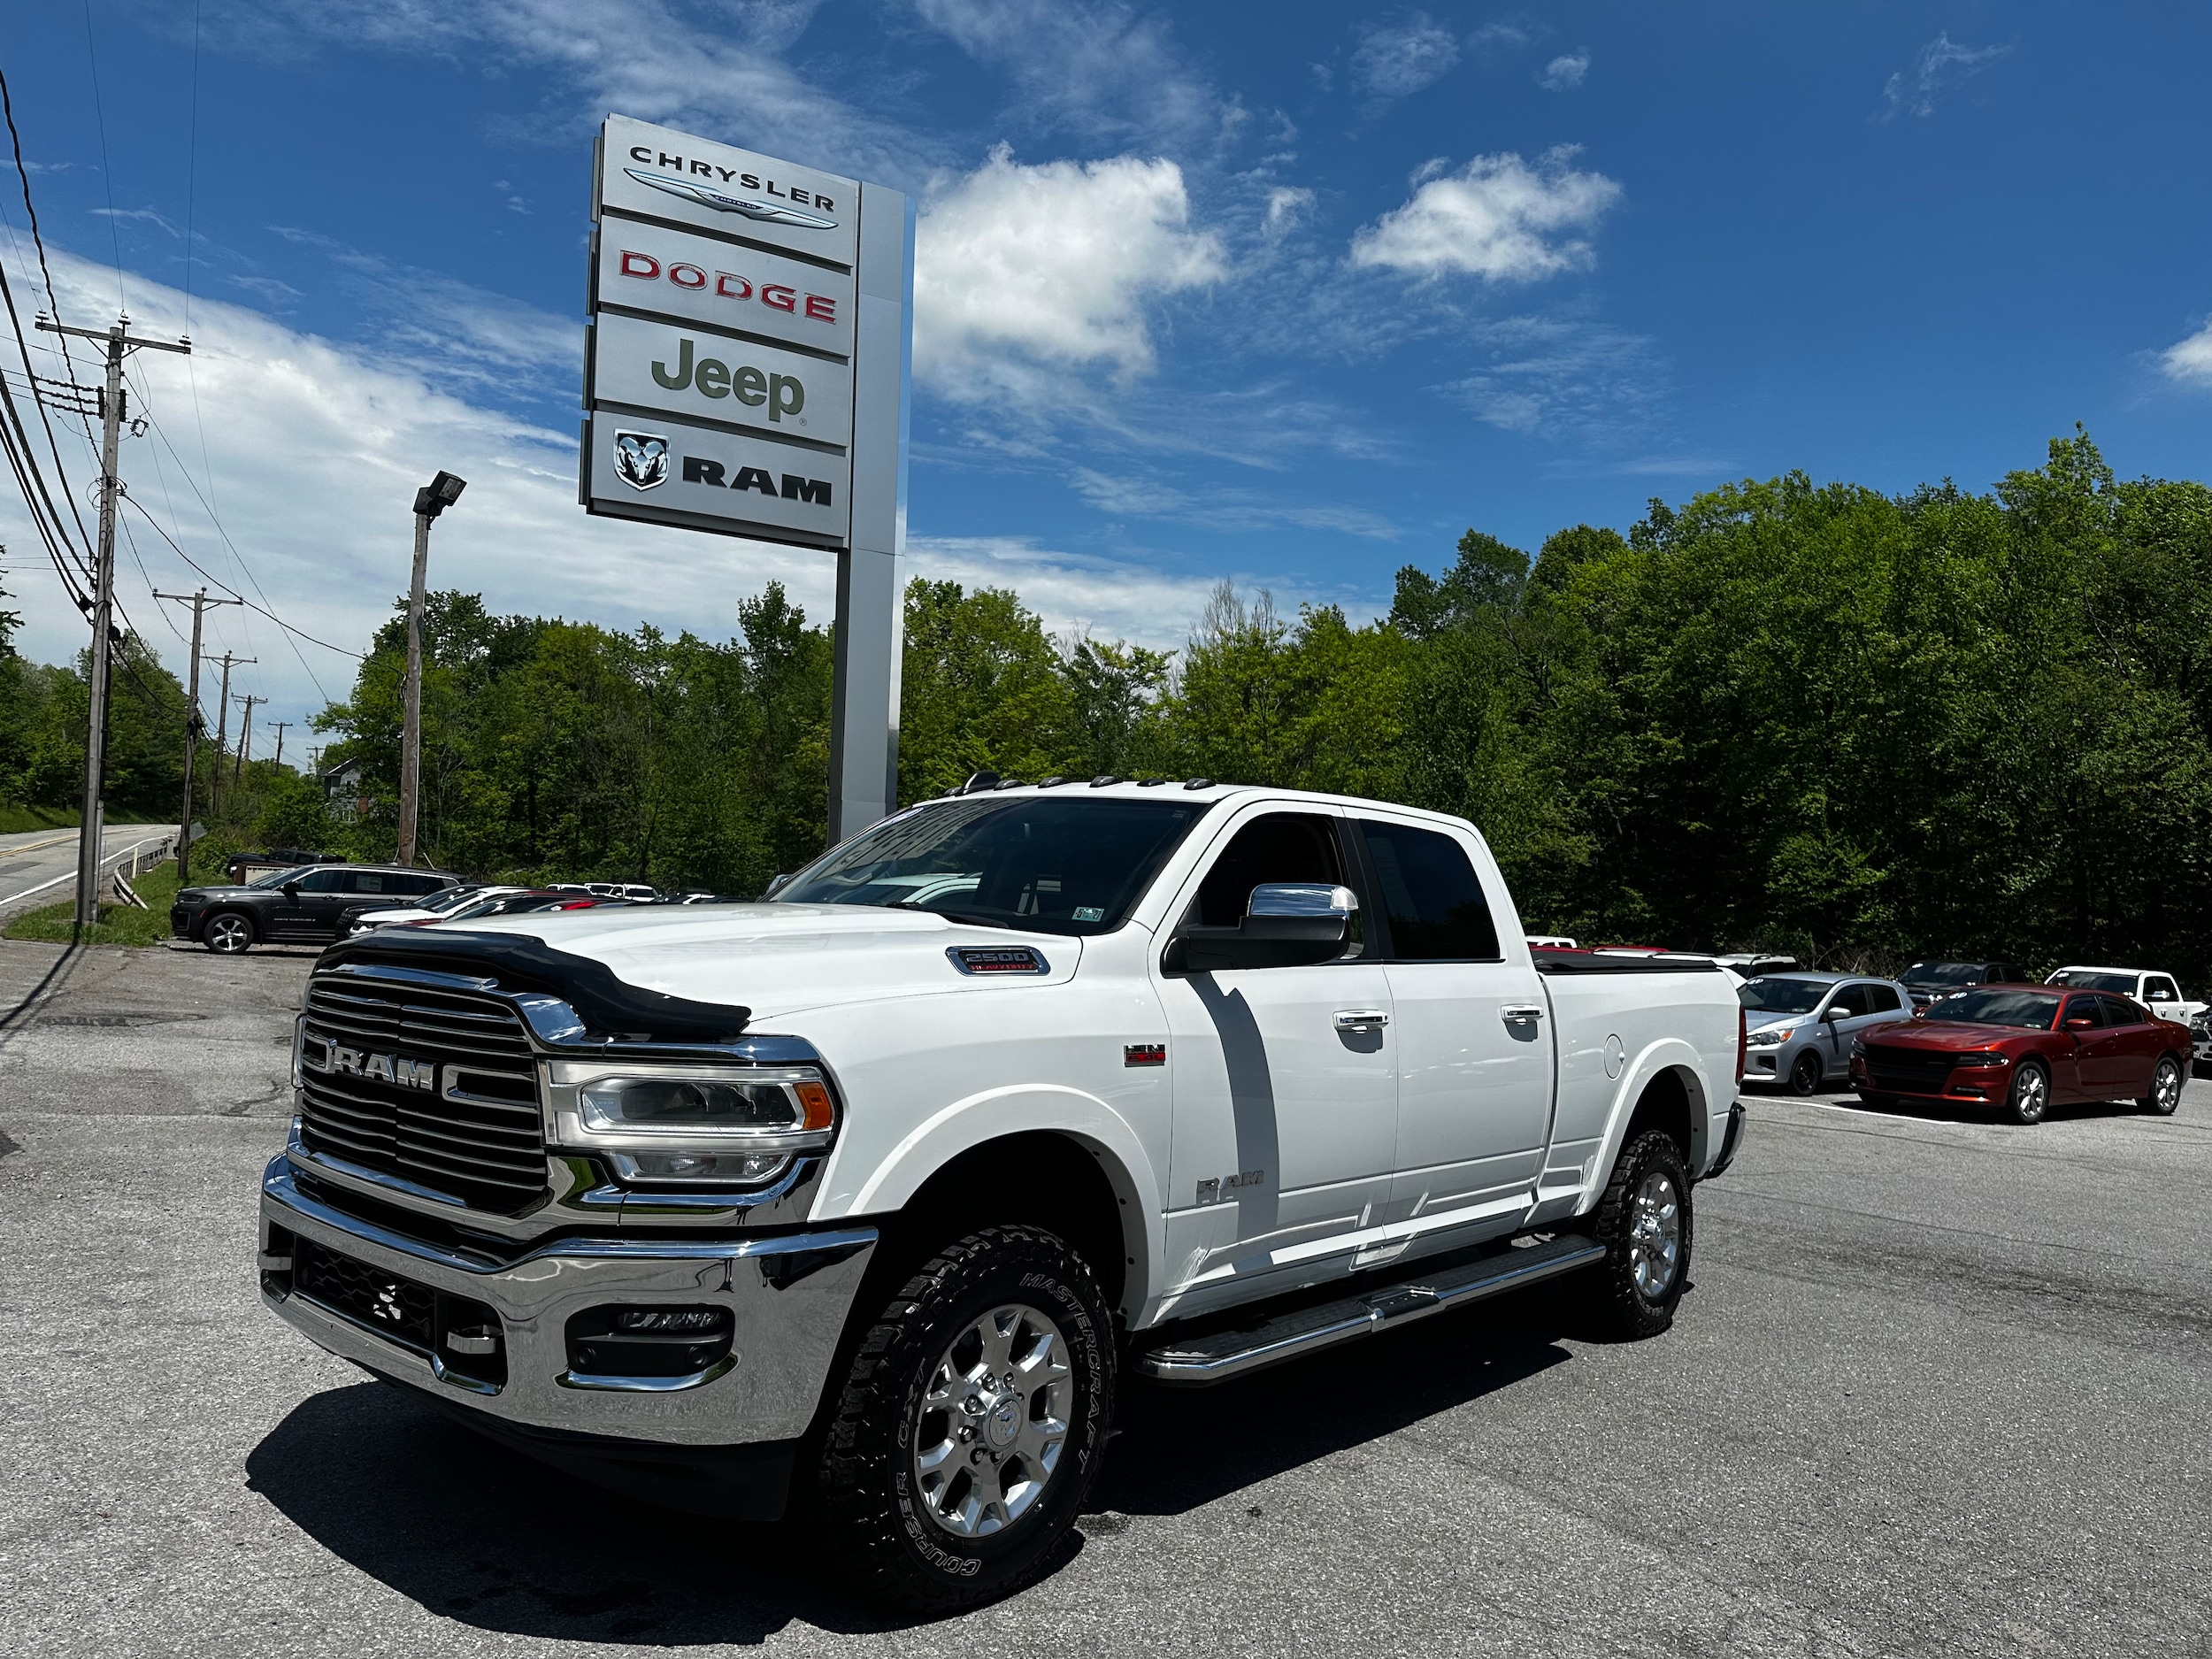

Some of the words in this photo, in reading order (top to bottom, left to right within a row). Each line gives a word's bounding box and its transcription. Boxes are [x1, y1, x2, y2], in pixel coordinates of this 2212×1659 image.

[629, 146, 836, 213] CHRYSLER
[619, 250, 837, 325] DODGE
[651, 338, 805, 423] Jeep
[682, 456, 833, 507] RAM
[965, 953, 1030, 964] 2500
[334, 1045, 434, 1092] RAM
[1124, 1044, 1165, 1054] HEMI
[1197, 1170, 1264, 1194] RAM
[1018, 1271, 1102, 1476] MASTERCRAFT
[895, 1471, 982, 1577] COURSER
